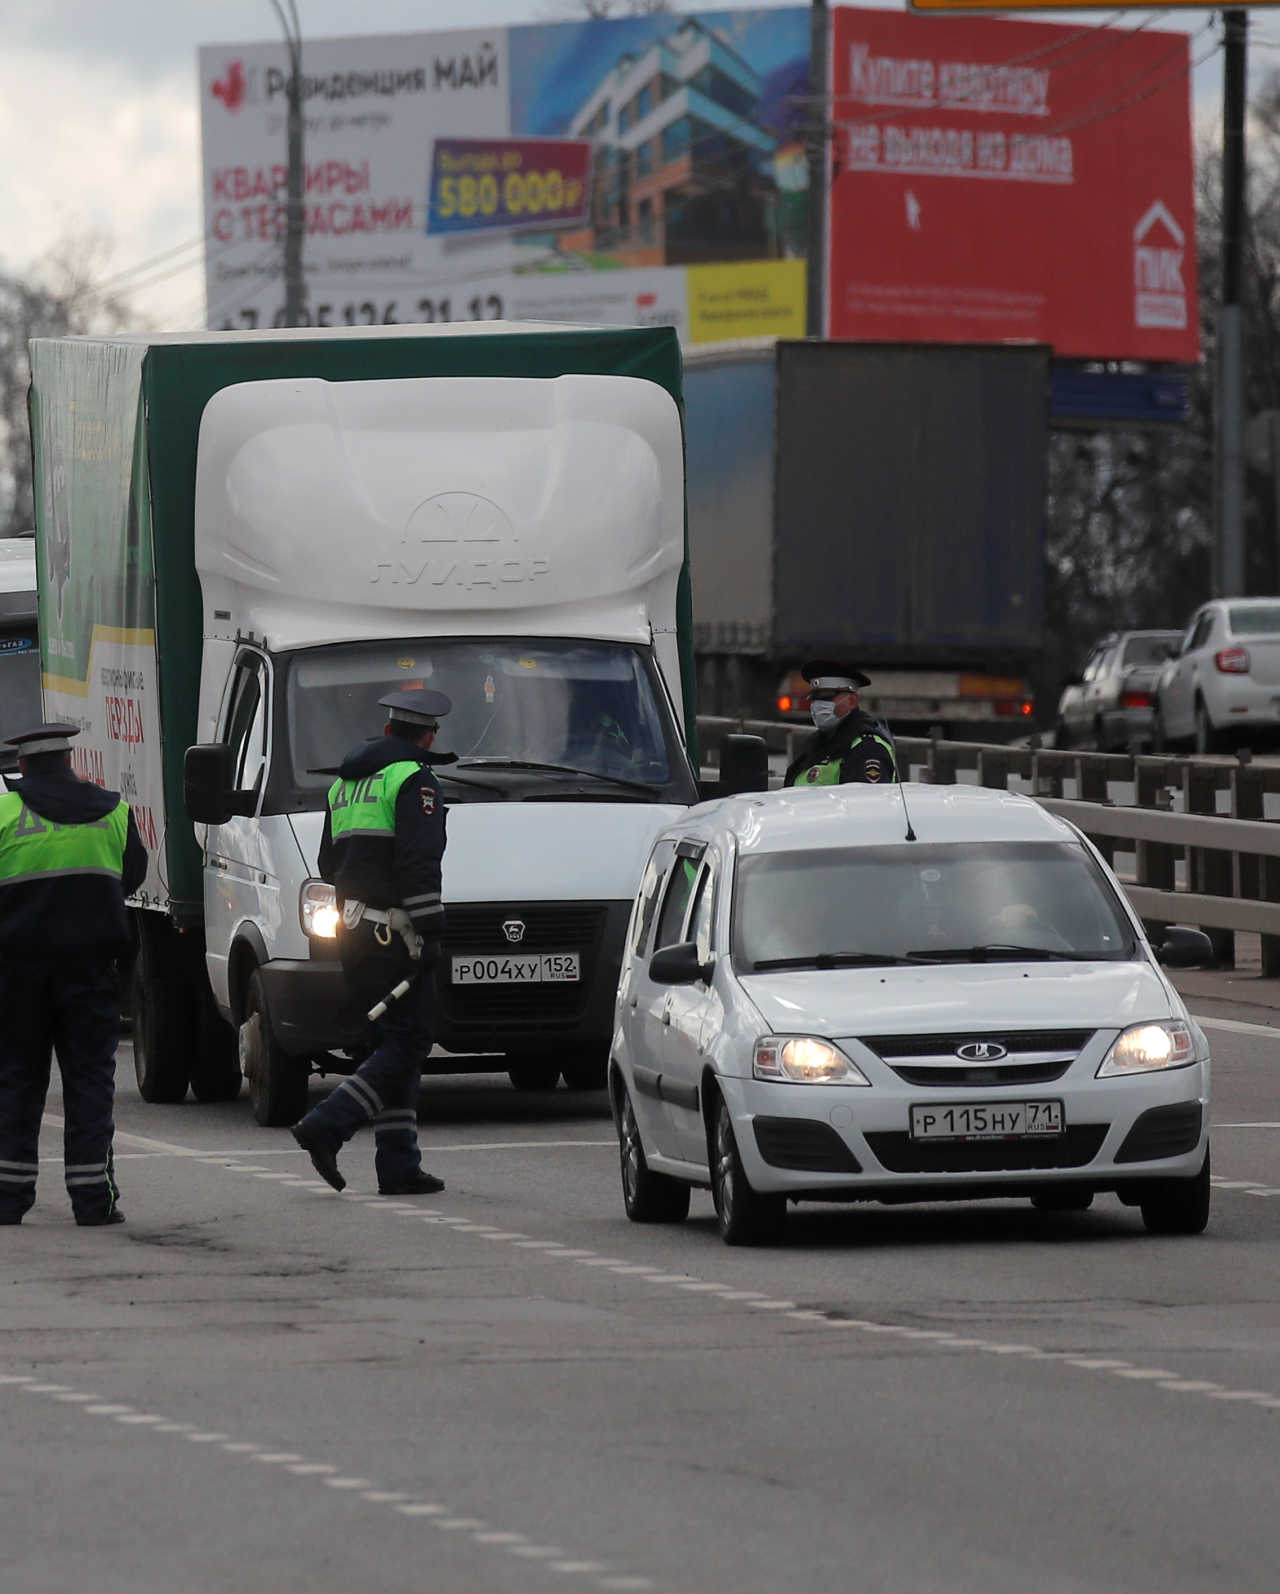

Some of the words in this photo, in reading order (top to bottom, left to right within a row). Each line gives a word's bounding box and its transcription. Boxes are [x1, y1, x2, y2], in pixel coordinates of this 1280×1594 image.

[432, 41, 498, 90] МАЙ
[849, 43, 935, 104] Купите
[939, 61, 1051, 112] квартиру
[849, 123, 880, 165] не
[883, 126, 973, 168] выходя
[976, 130, 1007, 171] из
[1009, 133, 1073, 177] дома
[211, 157, 370, 203] КВАРИРЫ
[438, 171, 498, 217] 580
[211, 208, 234, 242] С
[1134, 247, 1187, 292] ПИК
[544, 957, 574, 972] 152
[1028, 1105, 1053, 1123] 71
